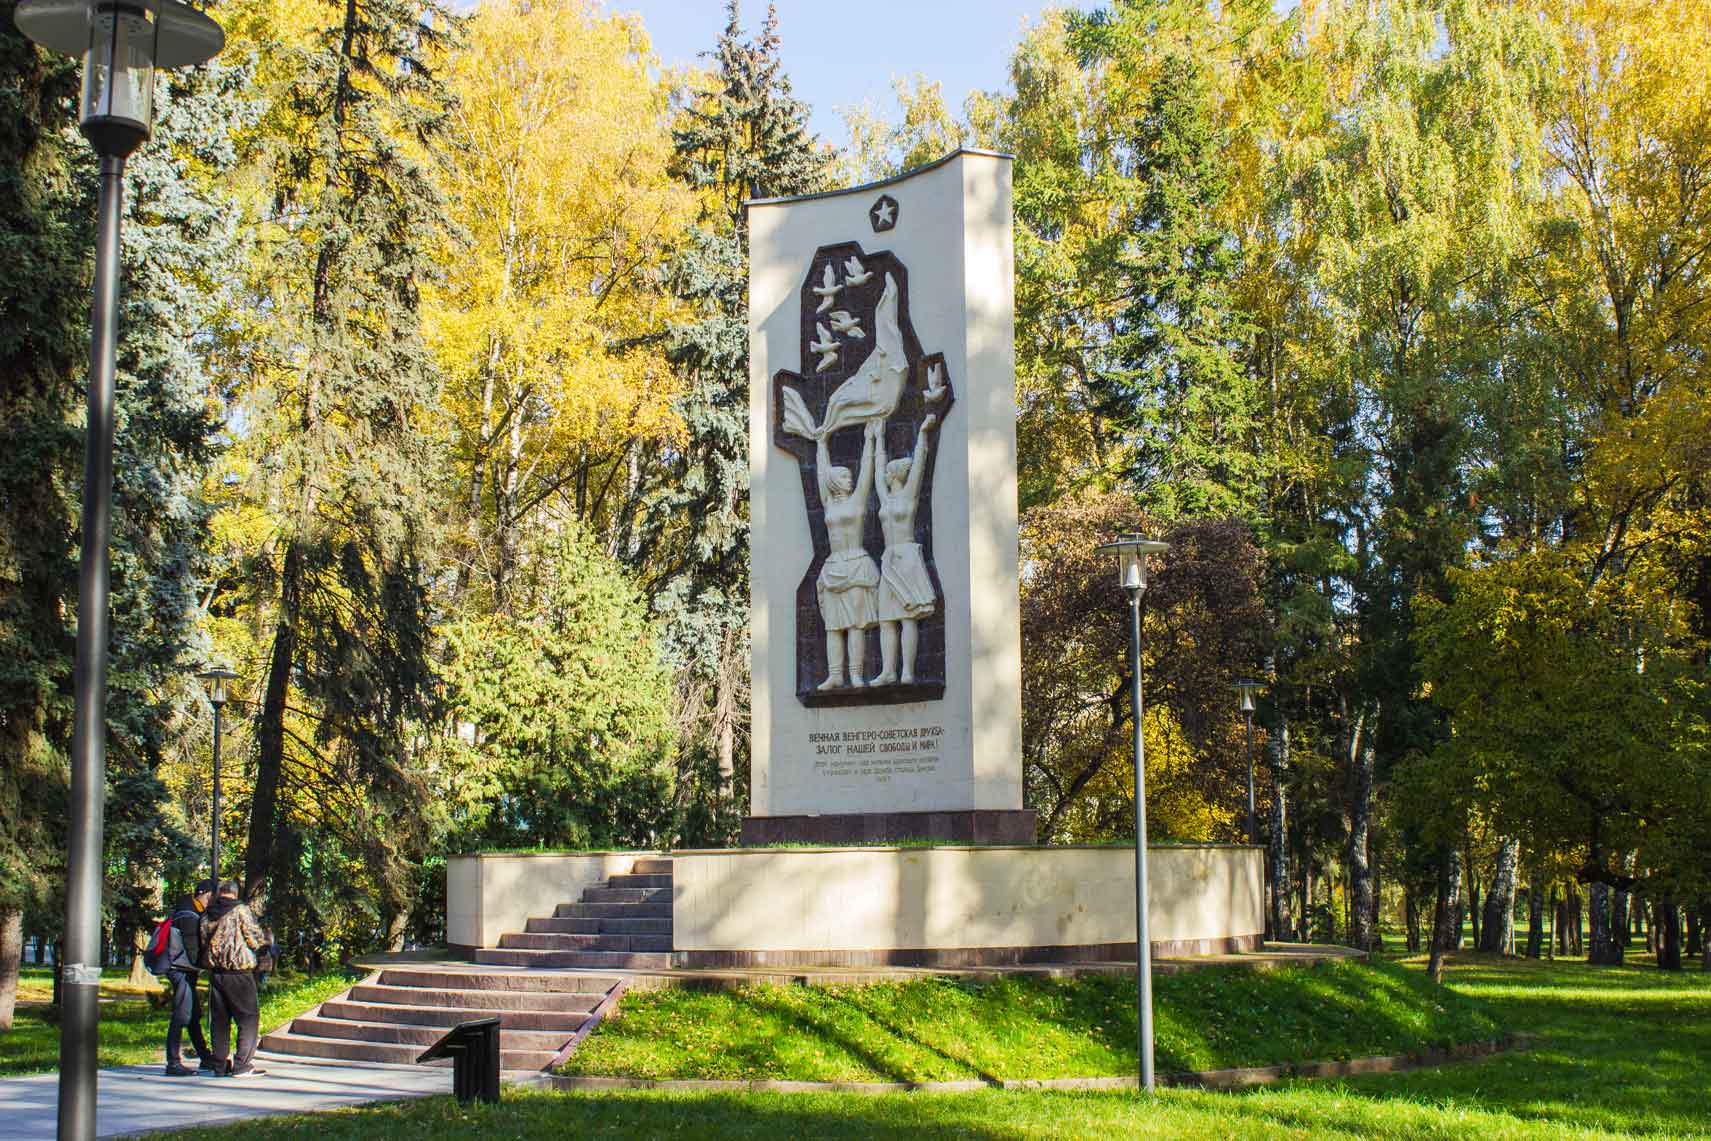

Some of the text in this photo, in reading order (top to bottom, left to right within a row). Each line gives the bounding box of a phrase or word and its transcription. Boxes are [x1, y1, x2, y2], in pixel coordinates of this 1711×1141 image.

[809, 732, 840, 743] ВЕЧНАЯ
[816, 744, 842, 755] ЗАЛОГ
[847, 743, 876, 753] НАШЕЙ
[879, 741, 911, 752] СВОБОДЫ
[912, 740, 918, 750] И
